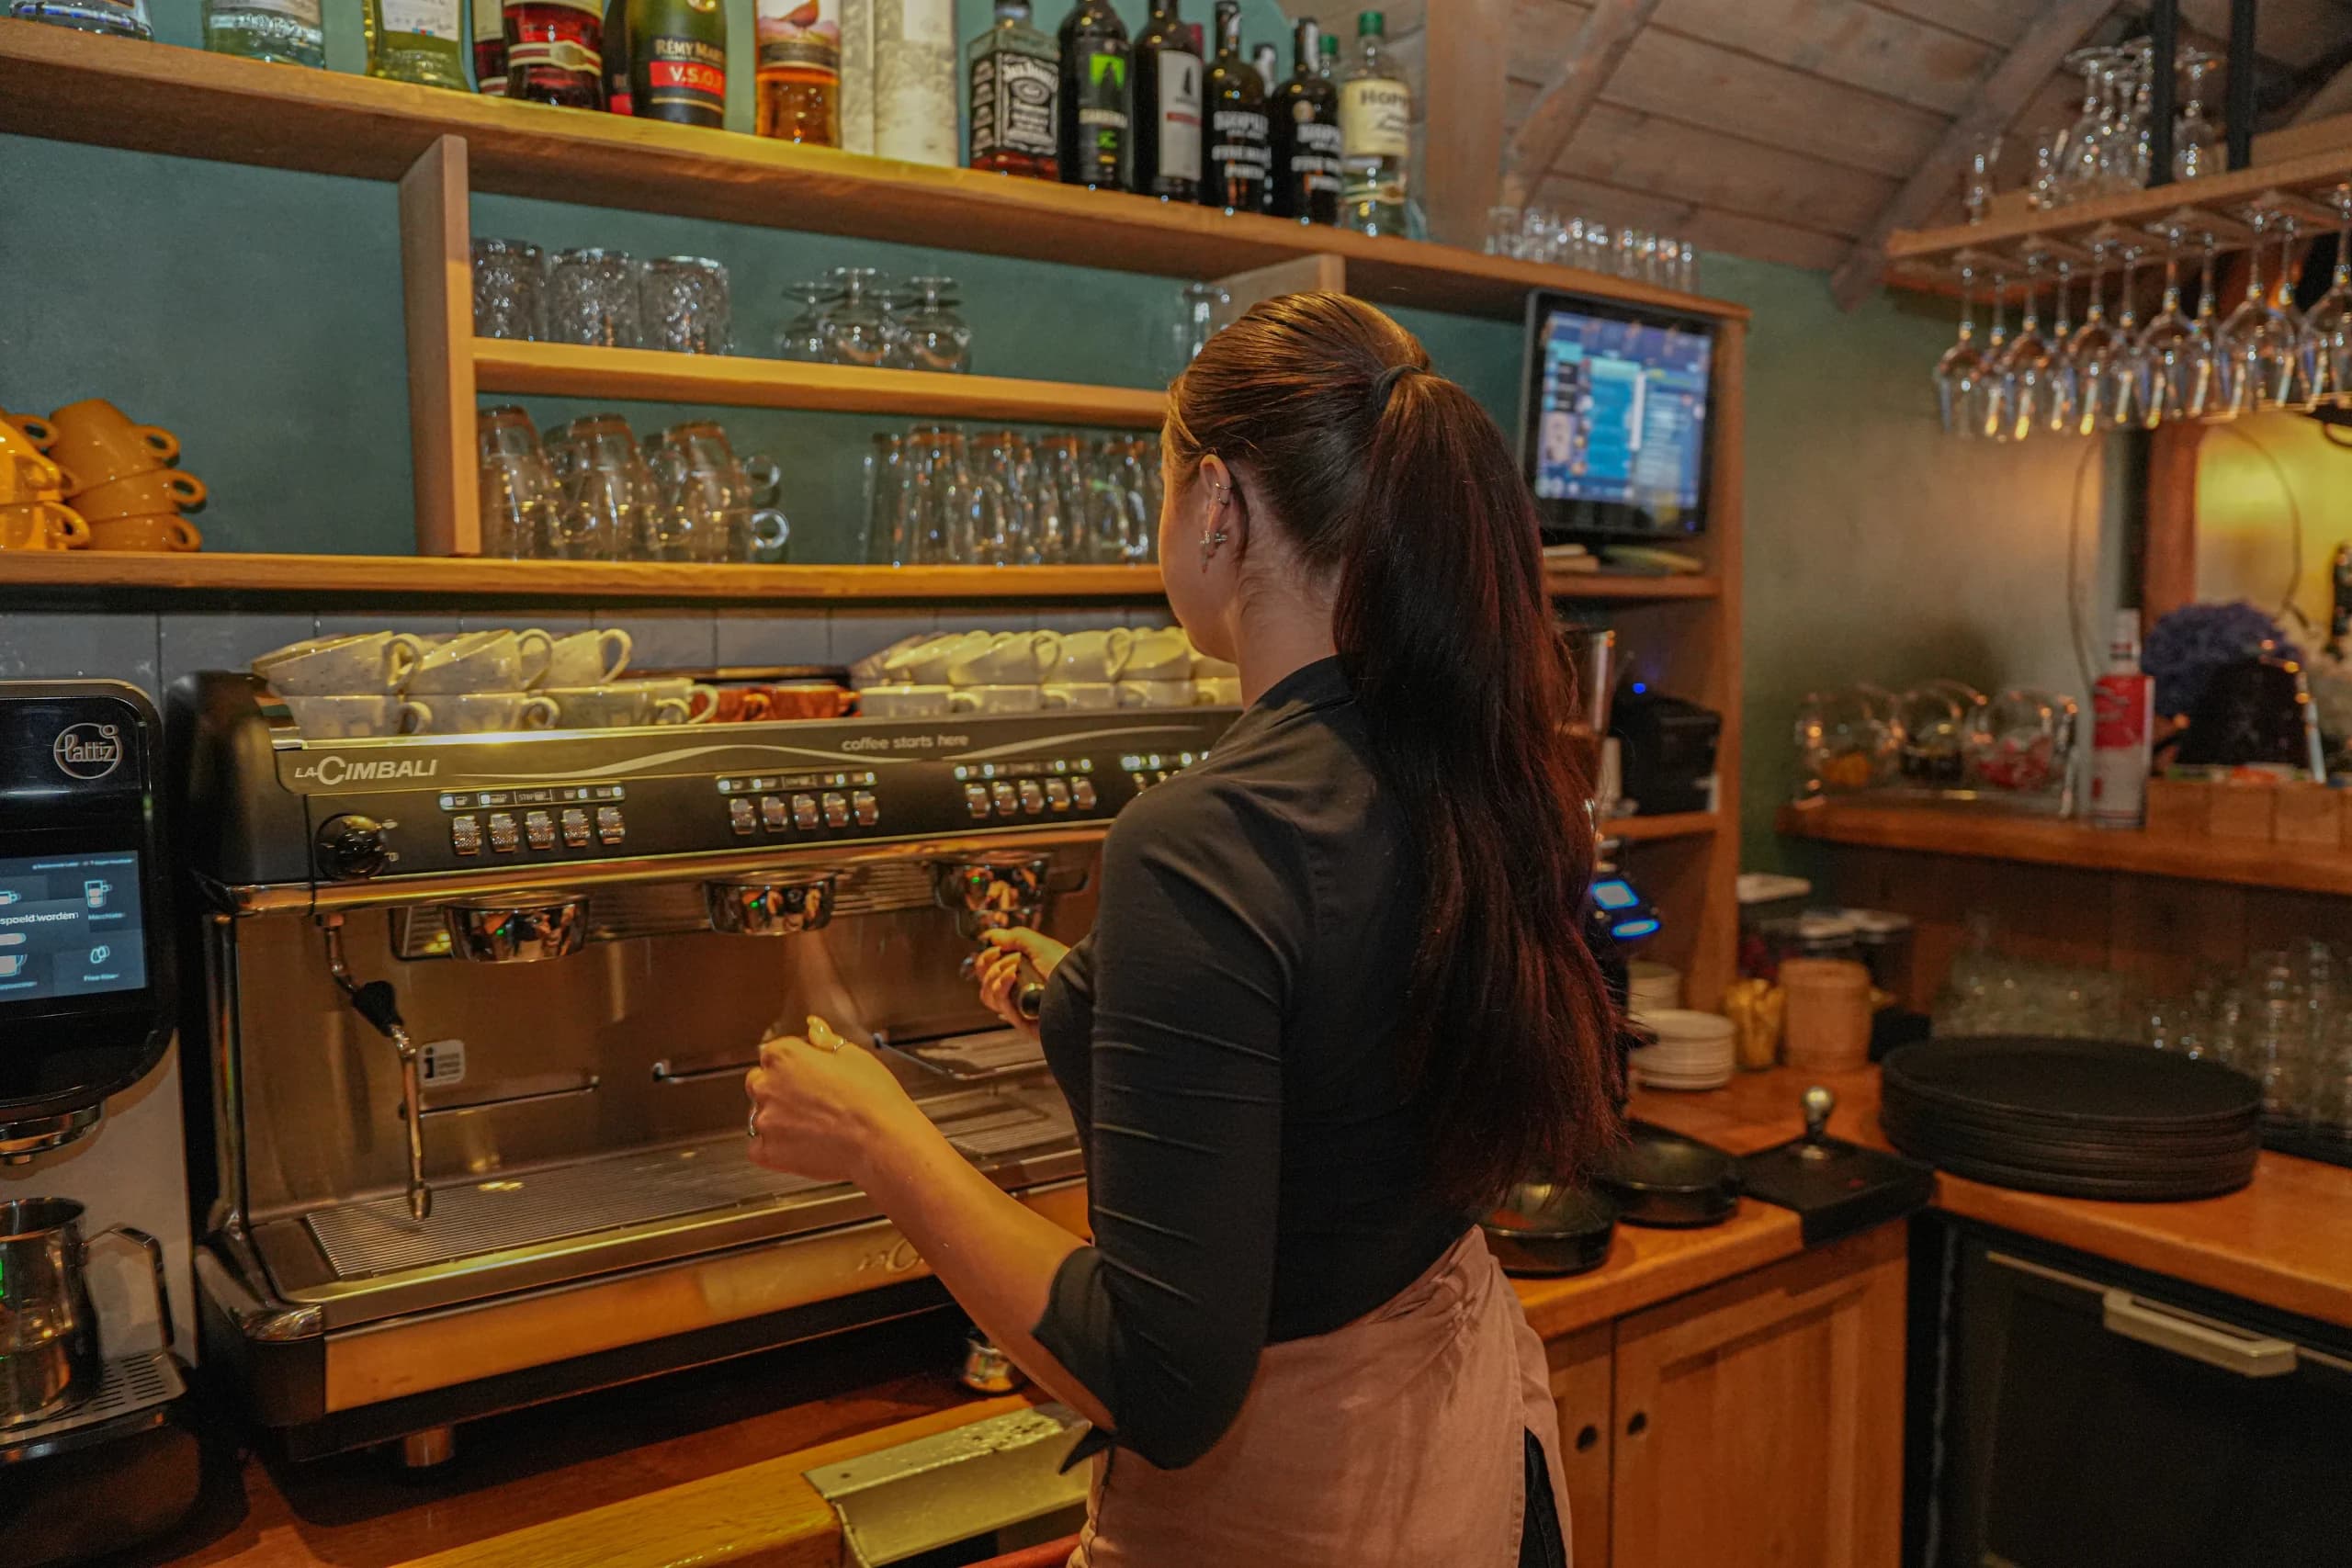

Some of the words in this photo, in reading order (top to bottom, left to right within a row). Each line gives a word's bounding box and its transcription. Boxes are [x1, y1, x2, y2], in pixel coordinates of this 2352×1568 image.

[841, 736, 889, 751] coffee
[892, 736, 933, 749] starts
[937, 734, 969, 747] here
[294, 766, 318, 778] LA
[317, 756, 438, 785] CIMBALI
[37, 911, 79, 922] worden
